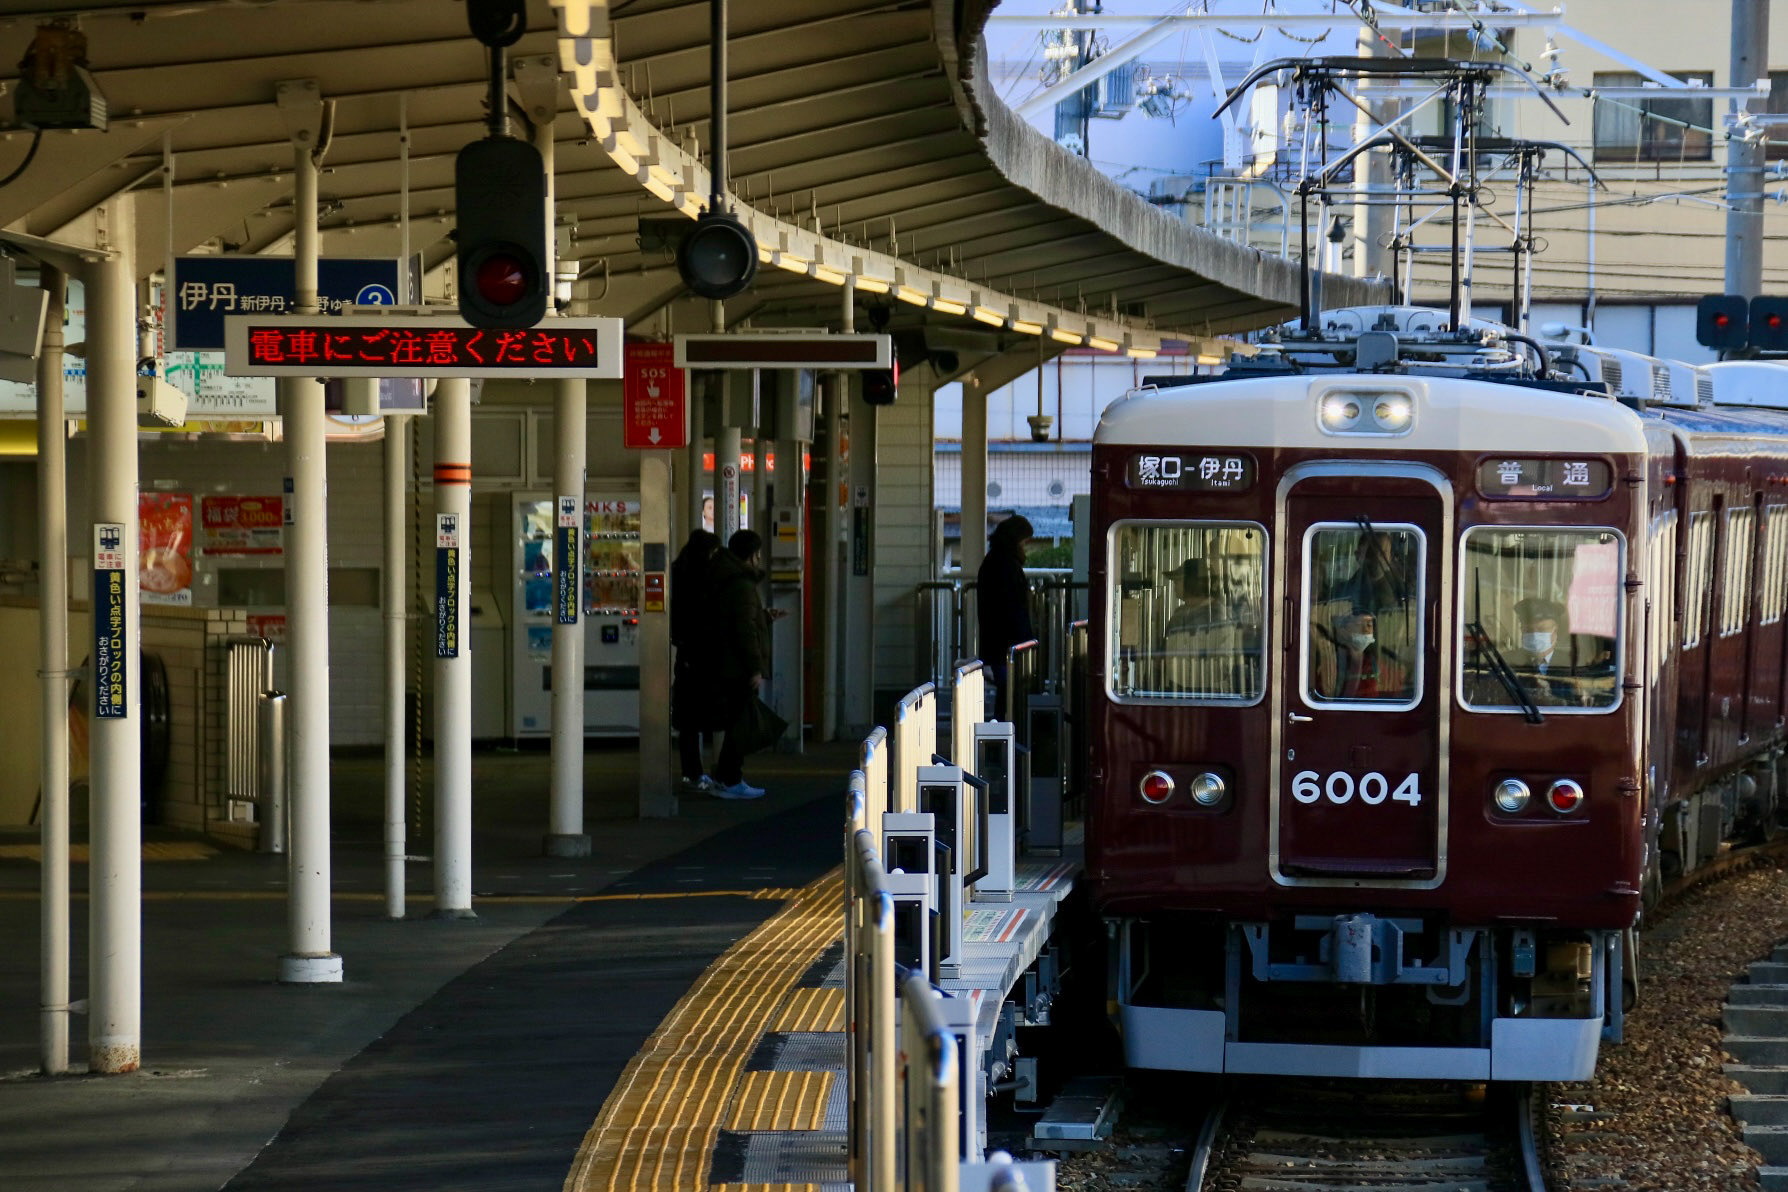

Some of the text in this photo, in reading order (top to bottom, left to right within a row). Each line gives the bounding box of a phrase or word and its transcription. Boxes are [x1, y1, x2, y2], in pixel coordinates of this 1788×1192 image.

[179, 282, 238, 311] 伊丹
[250, 329, 594, 364] 電車にご注意ください
[641, 368, 666, 378] SOS
[1532, 484, 1553, 492] Local
[588, 501, 627, 513] NKS
[98, 553, 122, 561] 電車に
[110, 571, 122, 715] 黄色い点字ブロックの内側に
[98, 637, 109, 715] おさがりください
[1291, 770, 1422, 806] 6004
